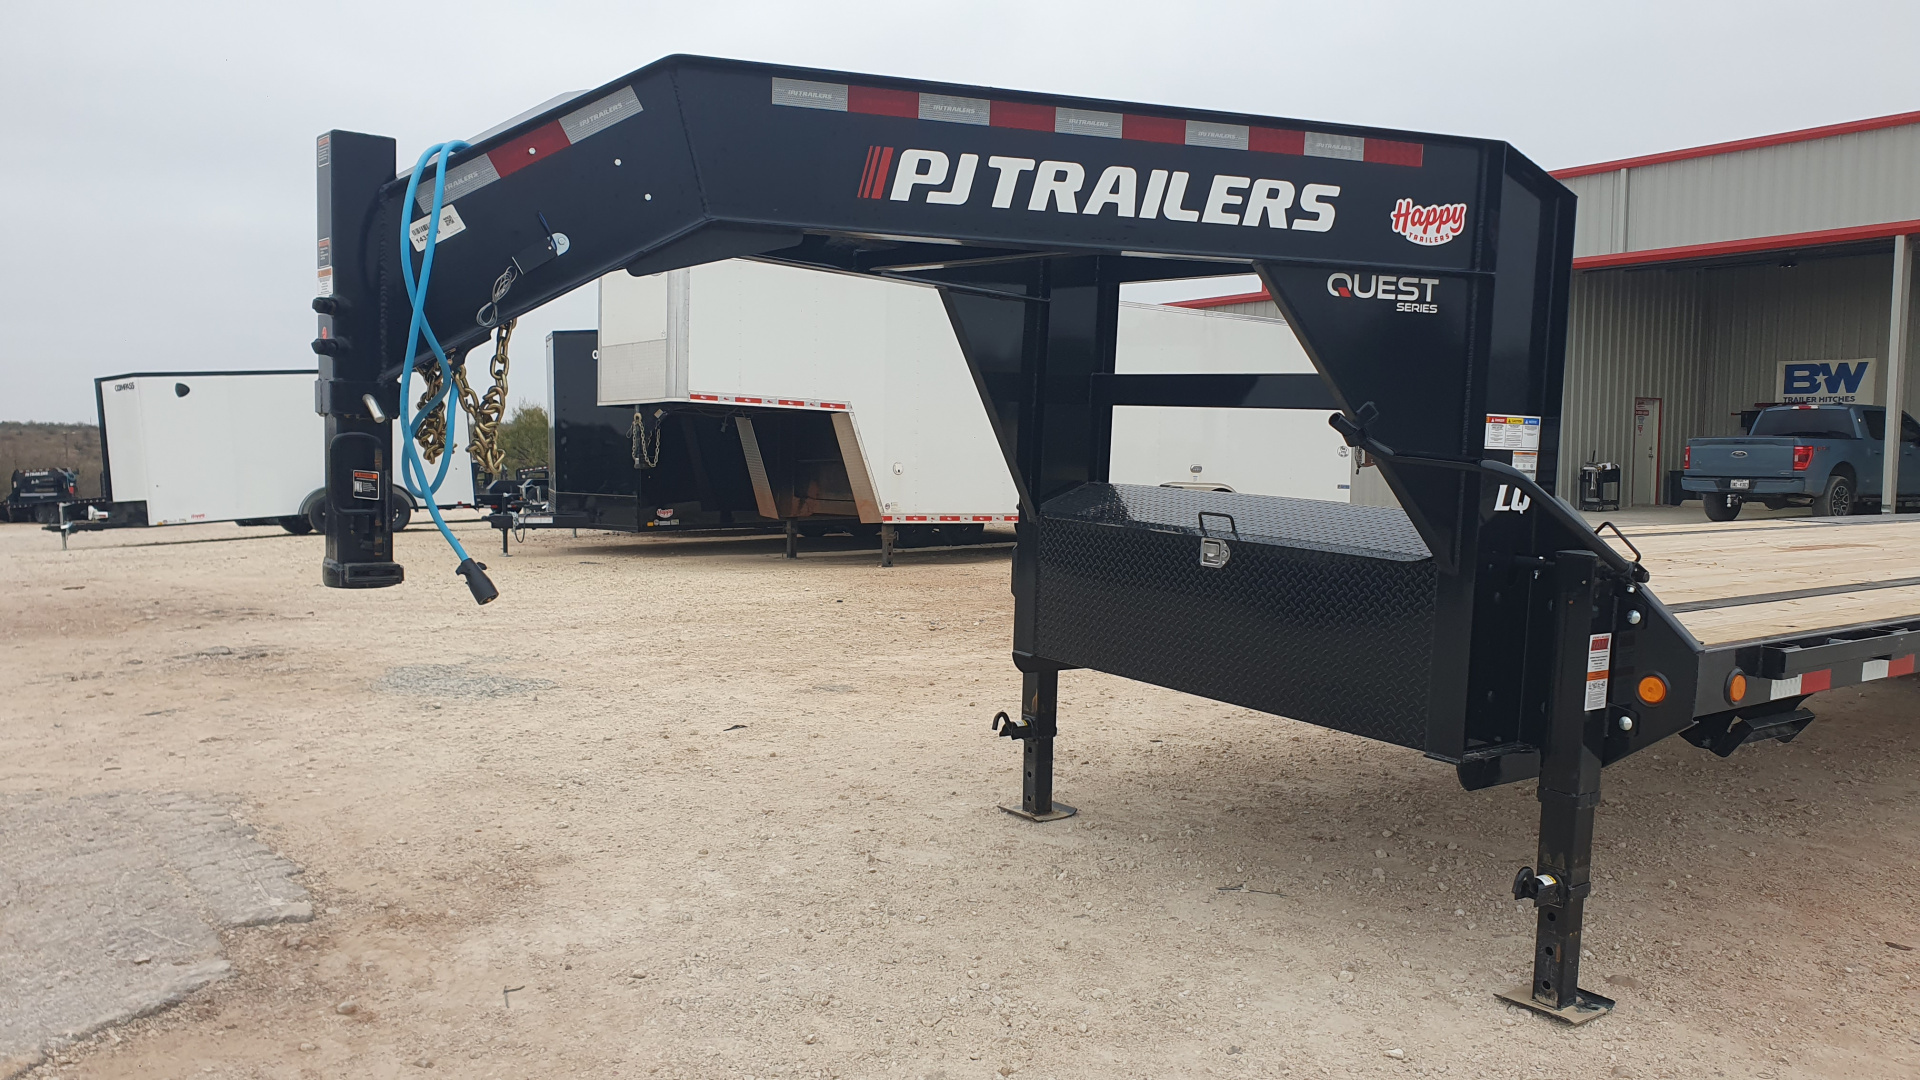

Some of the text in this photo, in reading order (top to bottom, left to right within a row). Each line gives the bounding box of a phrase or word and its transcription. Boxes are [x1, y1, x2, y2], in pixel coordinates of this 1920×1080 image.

[889, 149, 1342, 233] PJ TRAILERS
[1393, 201, 1465, 234] Happy
[1408, 232, 1450, 243] TRAILERS
[1327, 272, 1440, 302] QUEST
[1396, 302, 1438, 313] SERIES
[114, 382, 135, 392] COMPASS
[1818, 395, 1856, 403] HITCHES
